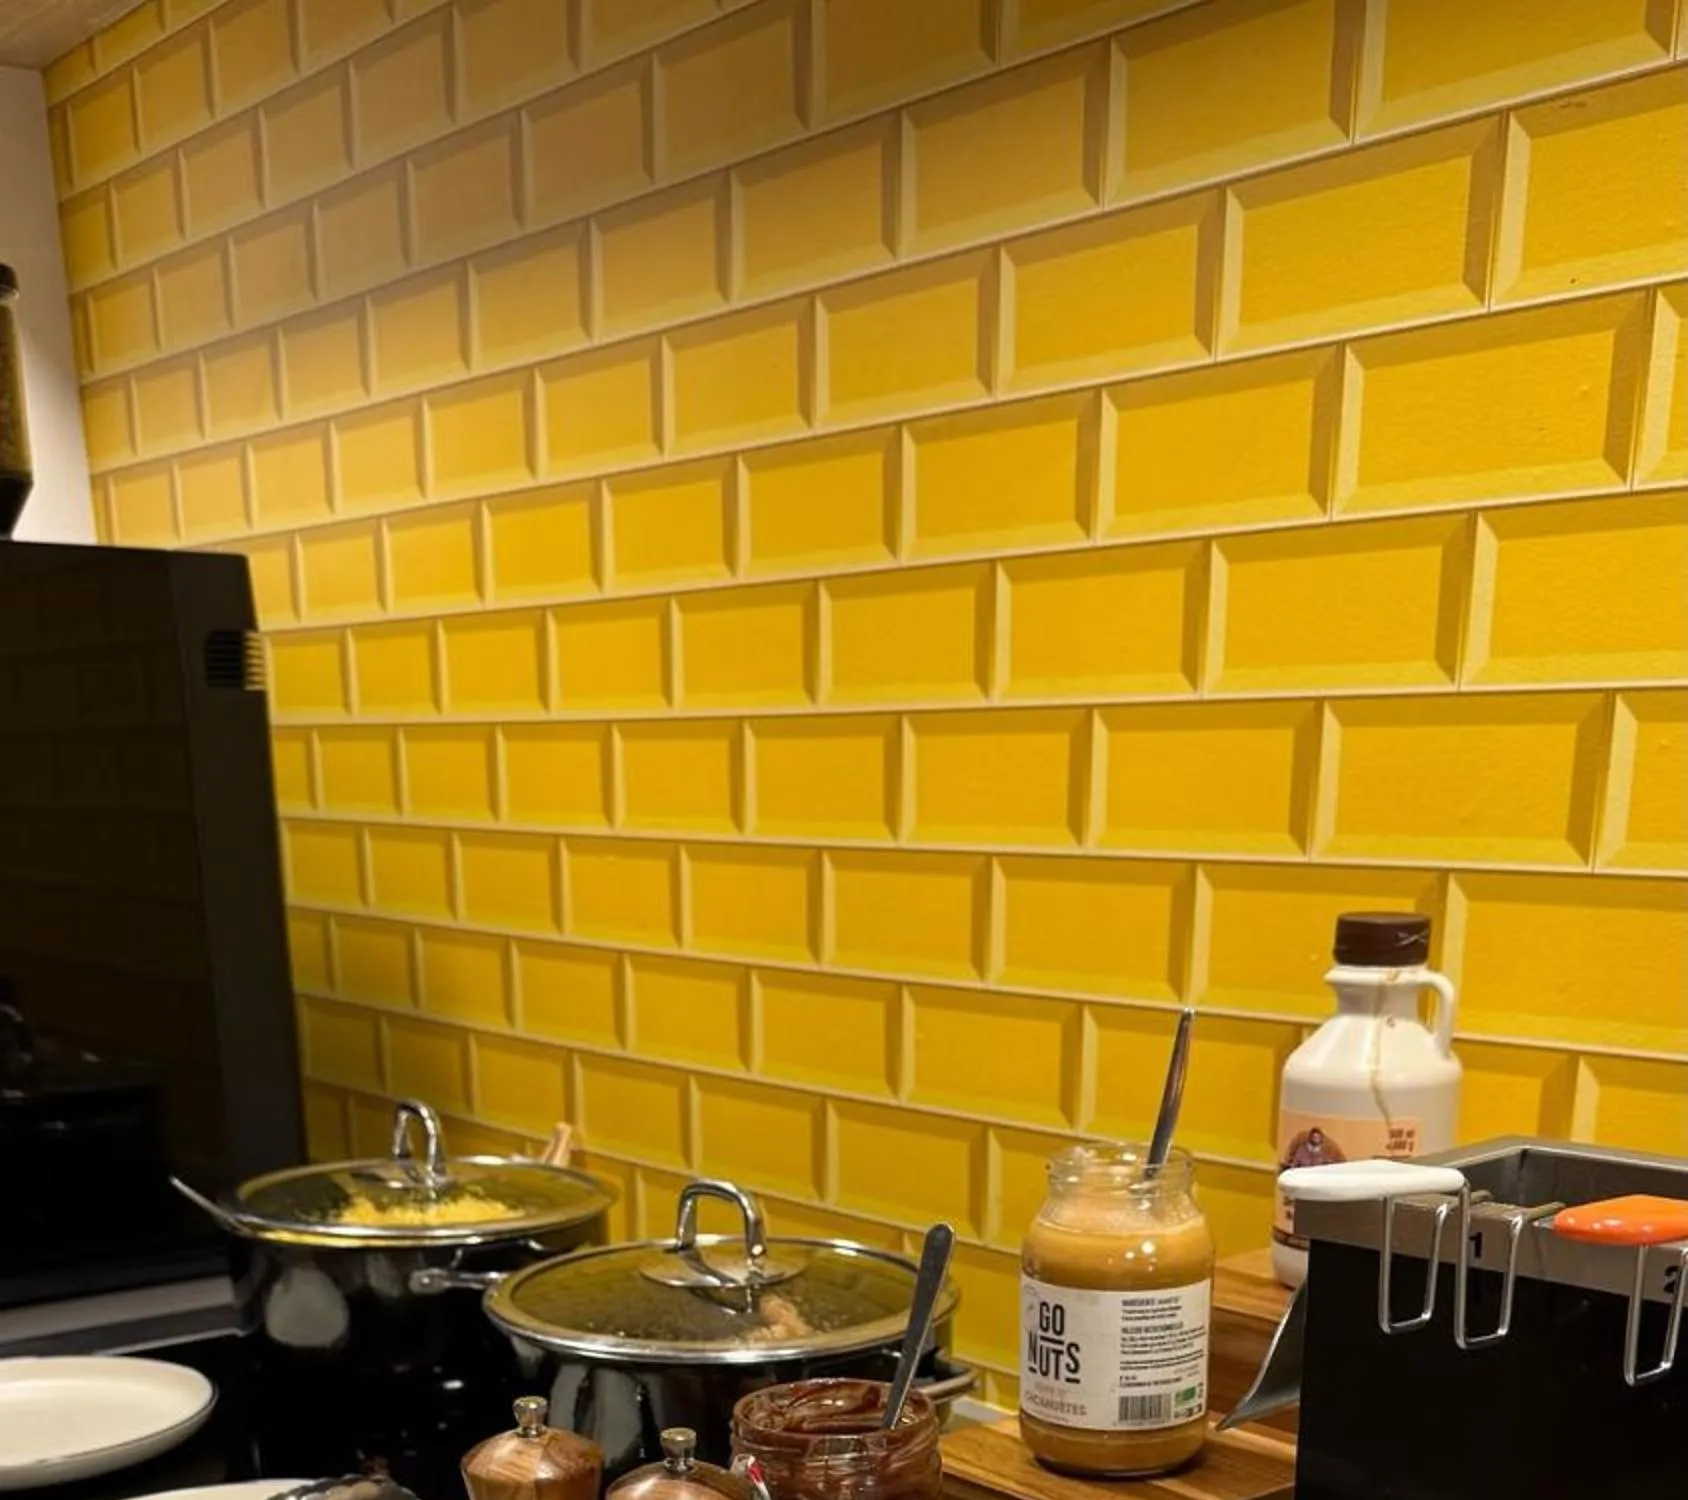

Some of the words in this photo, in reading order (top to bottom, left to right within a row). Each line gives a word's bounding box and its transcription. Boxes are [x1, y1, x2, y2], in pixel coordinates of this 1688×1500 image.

[1469, 1232, 1482, 1257] 1
[1664, 1266, 1681, 1293] 2
[1039, 1301, 1065, 1336] GO
[1027, 1331, 1081, 1381] NUTS
